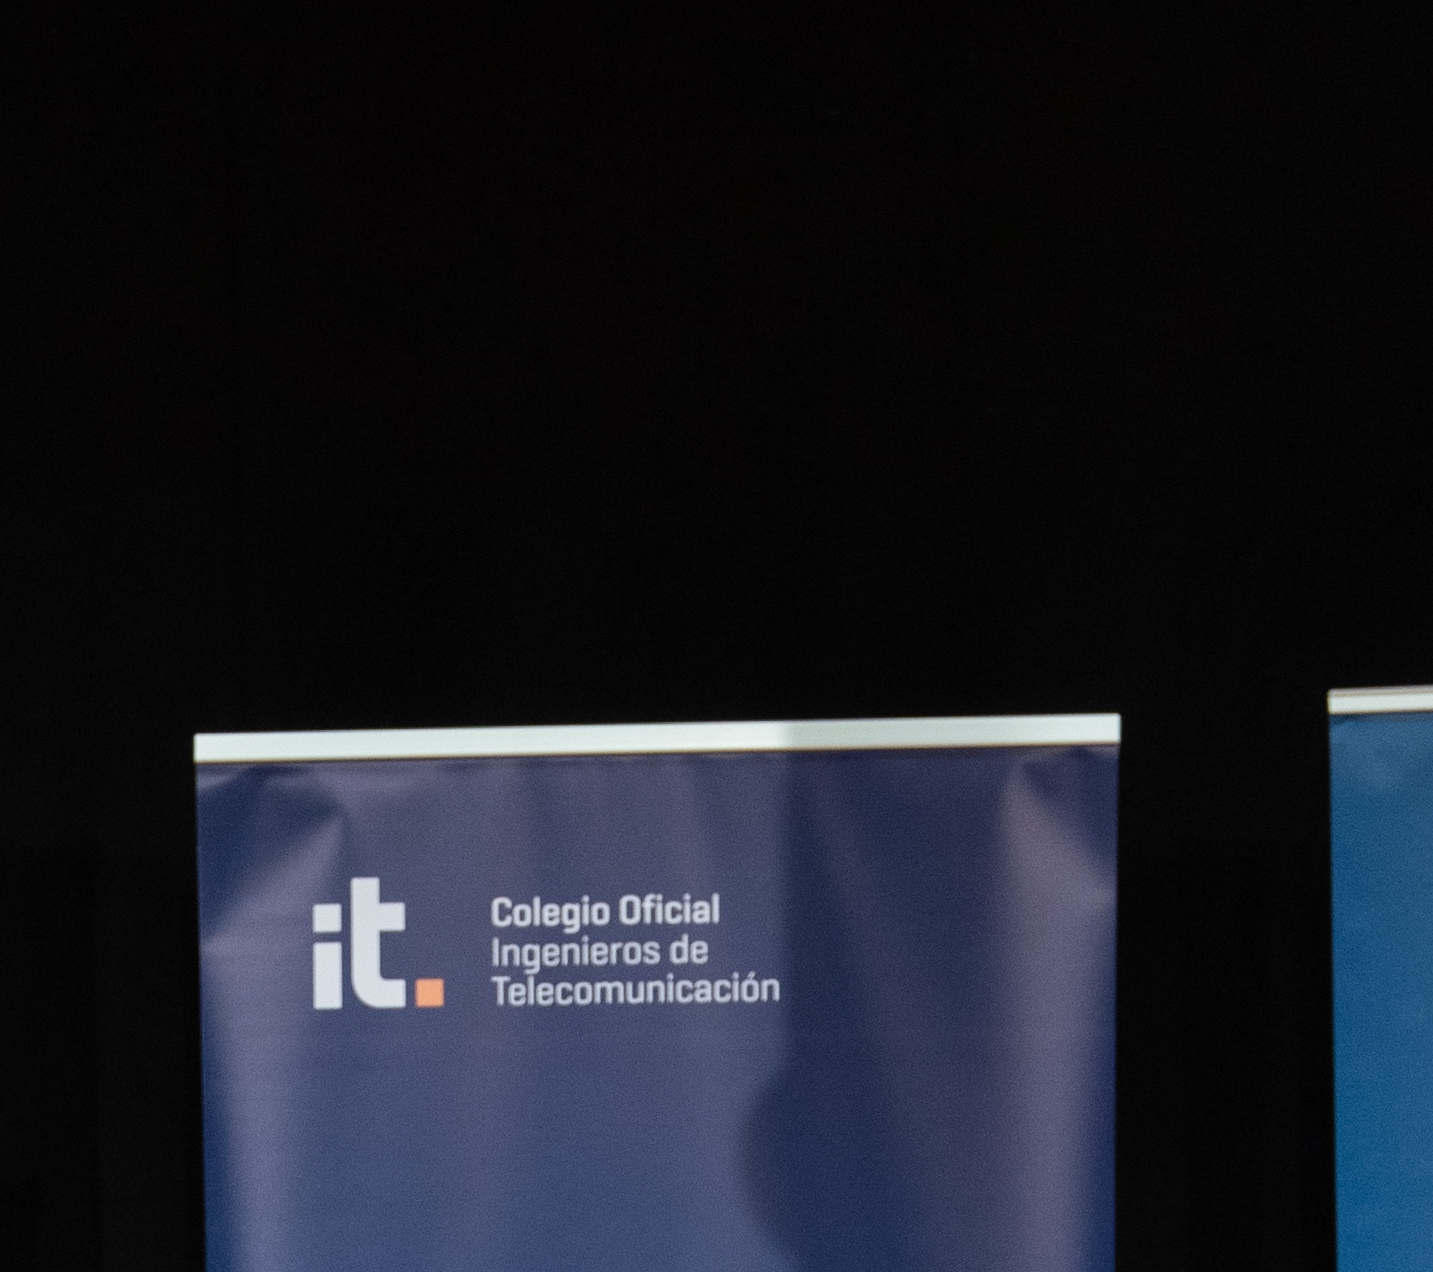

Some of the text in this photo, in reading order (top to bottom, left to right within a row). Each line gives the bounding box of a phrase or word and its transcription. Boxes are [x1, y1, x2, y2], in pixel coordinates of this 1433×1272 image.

[490, 892, 721, 934] Colegio Oficial
[491, 933, 709, 975] Ingenieros de
[491, 970, 782, 1008] Telecomunicación
